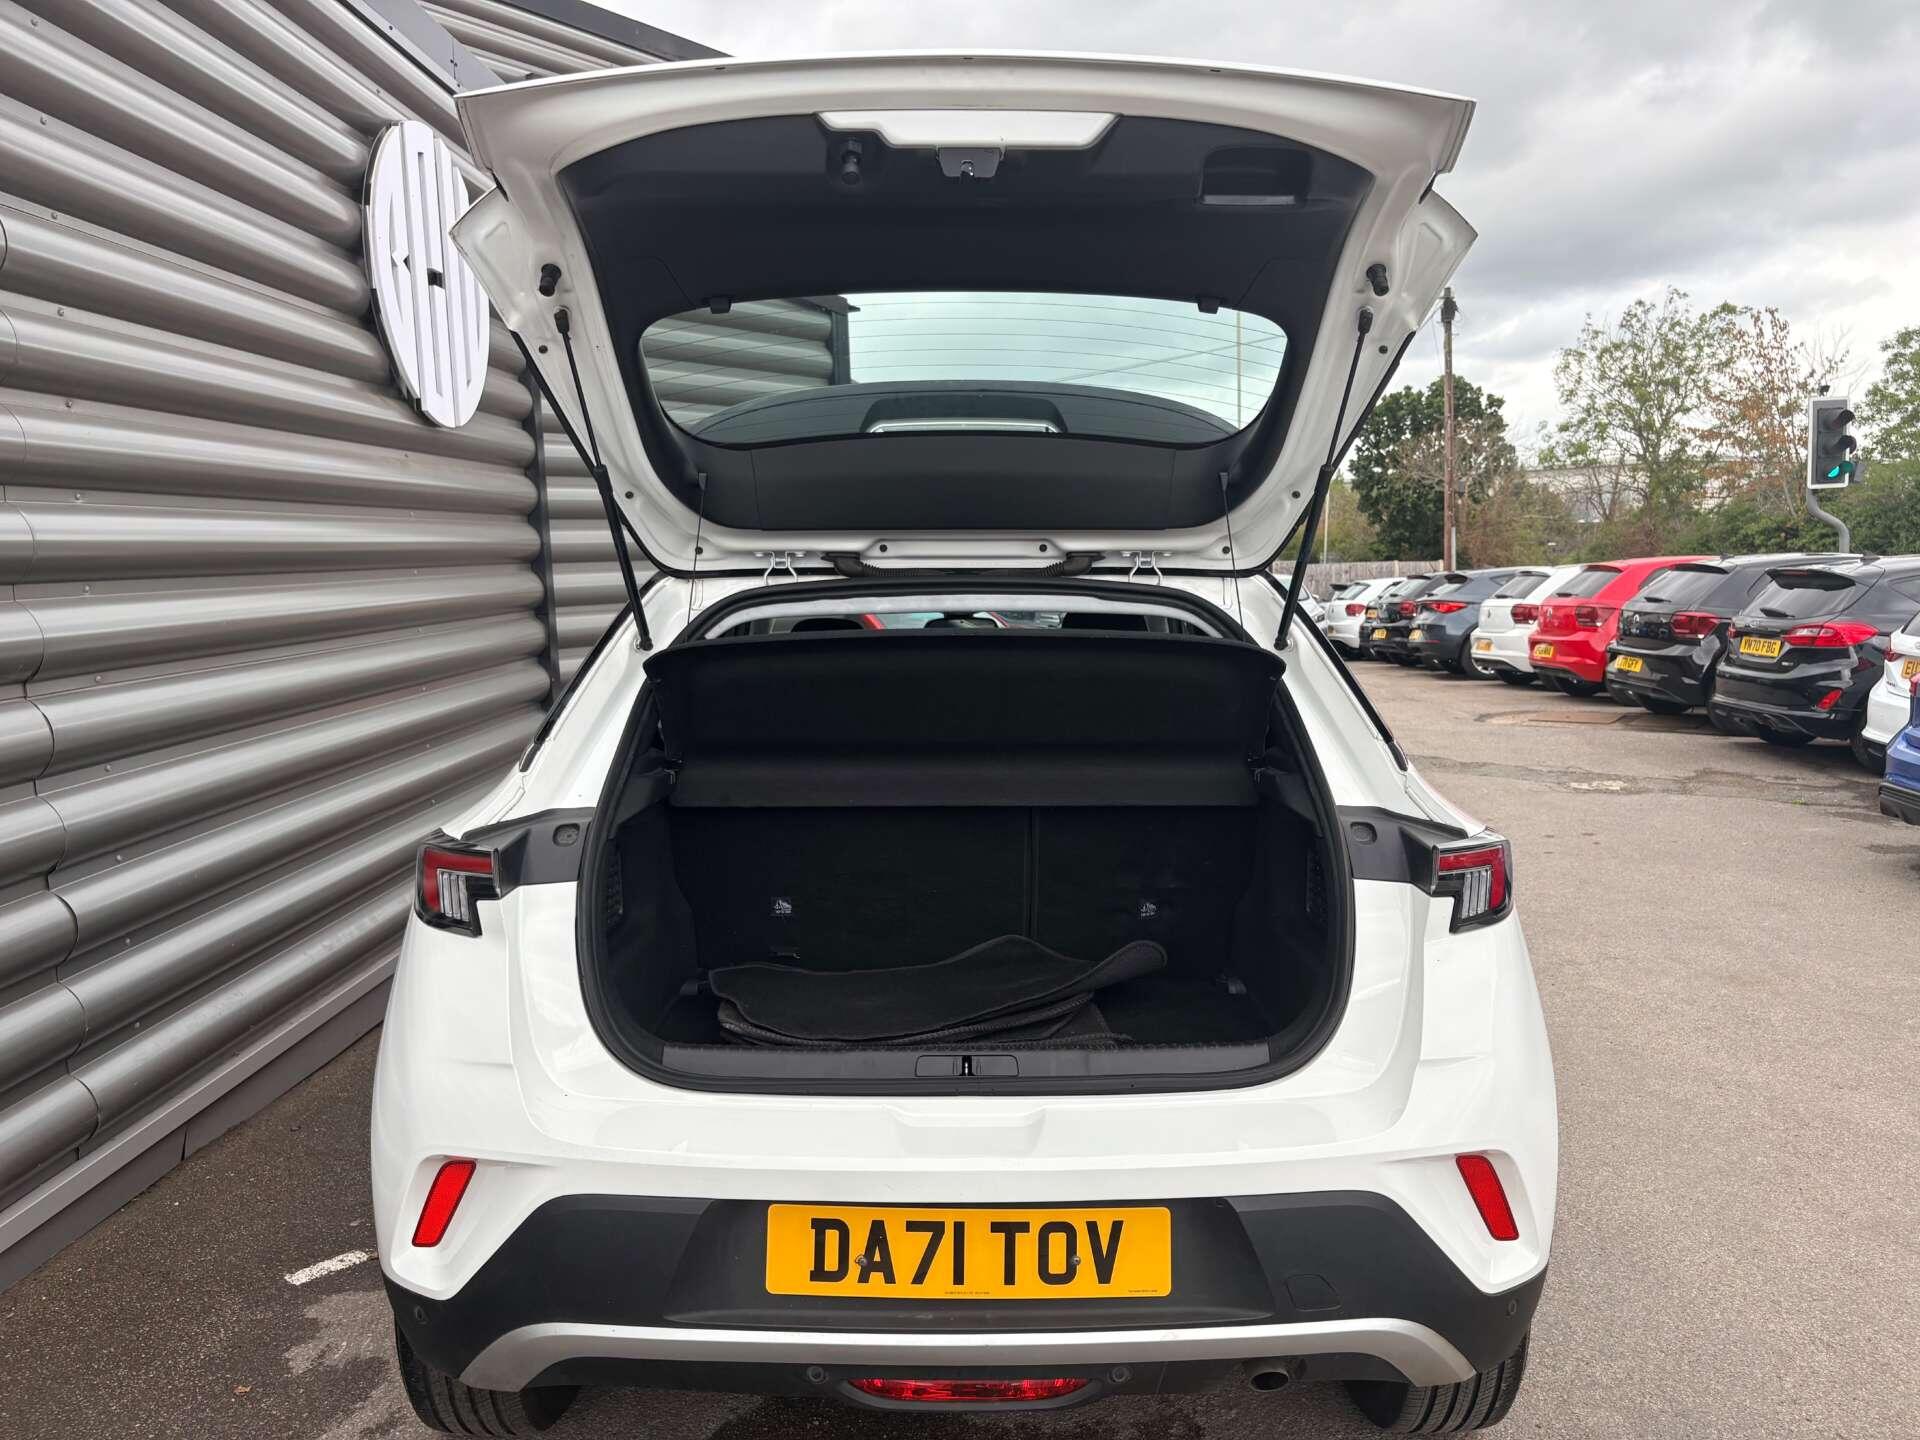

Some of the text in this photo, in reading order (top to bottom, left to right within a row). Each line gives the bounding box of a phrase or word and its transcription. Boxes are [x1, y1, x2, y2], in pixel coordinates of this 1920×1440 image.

[1904, 660, 1920, 675] EU
[809, 1217, 1124, 1286] DA71 TOV
